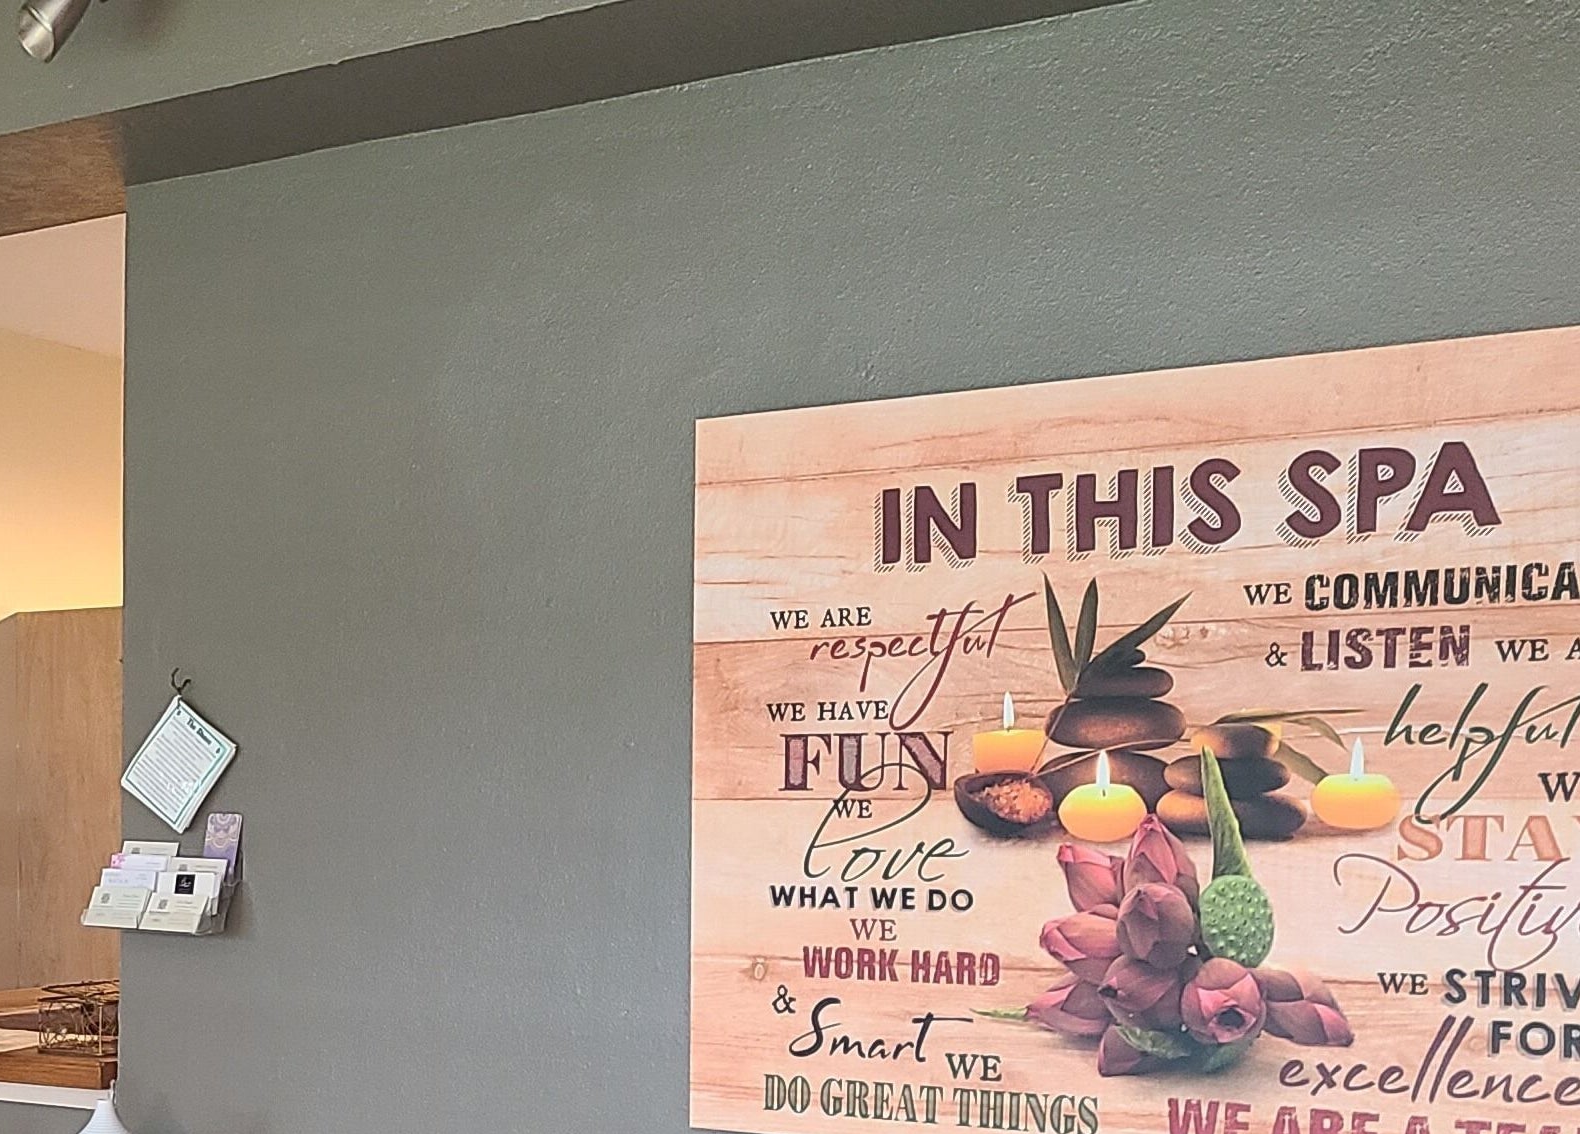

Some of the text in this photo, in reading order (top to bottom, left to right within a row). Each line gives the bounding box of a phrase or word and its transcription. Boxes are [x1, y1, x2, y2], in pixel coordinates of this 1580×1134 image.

[875, 441, 1502, 572] IN THIS SPA
[1243, 561, 1580, 612] WE COMMUNICA
[770, 607, 872, 630] WE ARE
[810, 592, 1037, 730] respectful
[1265, 642, 1288, 667] &
[1300, 624, 1471, 672] LISTEN
[1495, 639, 1549, 662] WE
[767, 700, 890, 722] WE HAVE
[778, 731, 954, 791] FUN
[1383, 682, 1580, 824] helpful
[833, 799, 873, 819] WE
[1397, 815, 1580, 862] STA
[770, 885, 974, 911] WHAT WE DO
[1333, 853, 1580, 972] Positiv
[850, 919, 897, 941] WE
[802, 946, 1000, 986] WORK HARD
[1378, 971, 1428, 996] WE
[771, 984, 1002, 1082] & Smart WE
[1488, 1020, 1580, 1060] FOR
[1279, 1014, 1580, 1106] excellence
[764, 1073, 811, 1113] DO
[820, 1078, 943, 1125] GREAT
